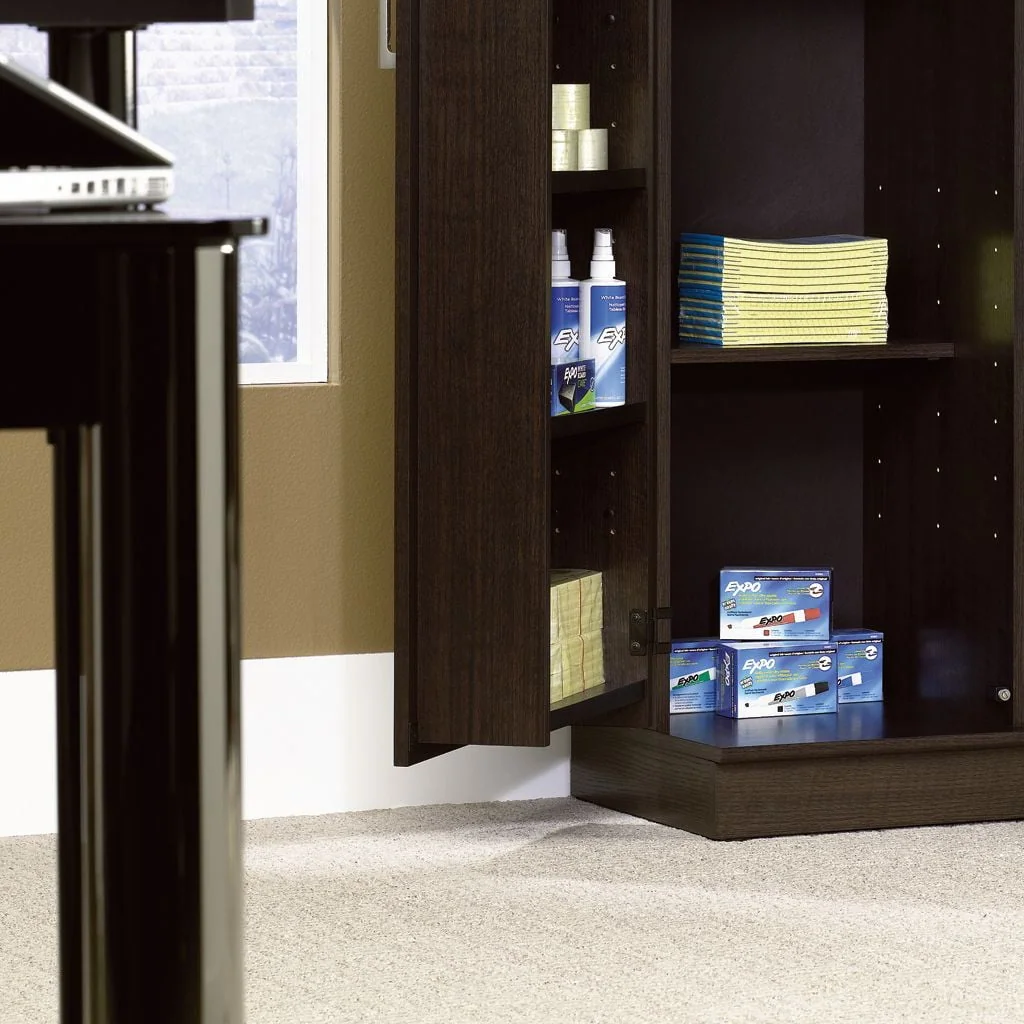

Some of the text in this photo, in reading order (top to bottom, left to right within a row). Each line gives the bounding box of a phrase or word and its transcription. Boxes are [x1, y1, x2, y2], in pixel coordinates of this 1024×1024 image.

[564, 367, 578, 384] EXPO
[725, 581, 761, 596] EXPO
[760, 615, 783, 626] EXPO
[742, 659, 775, 674] EXPO
[678, 674, 699, 686] EXPO
[774, 690, 795, 702] EXPO
